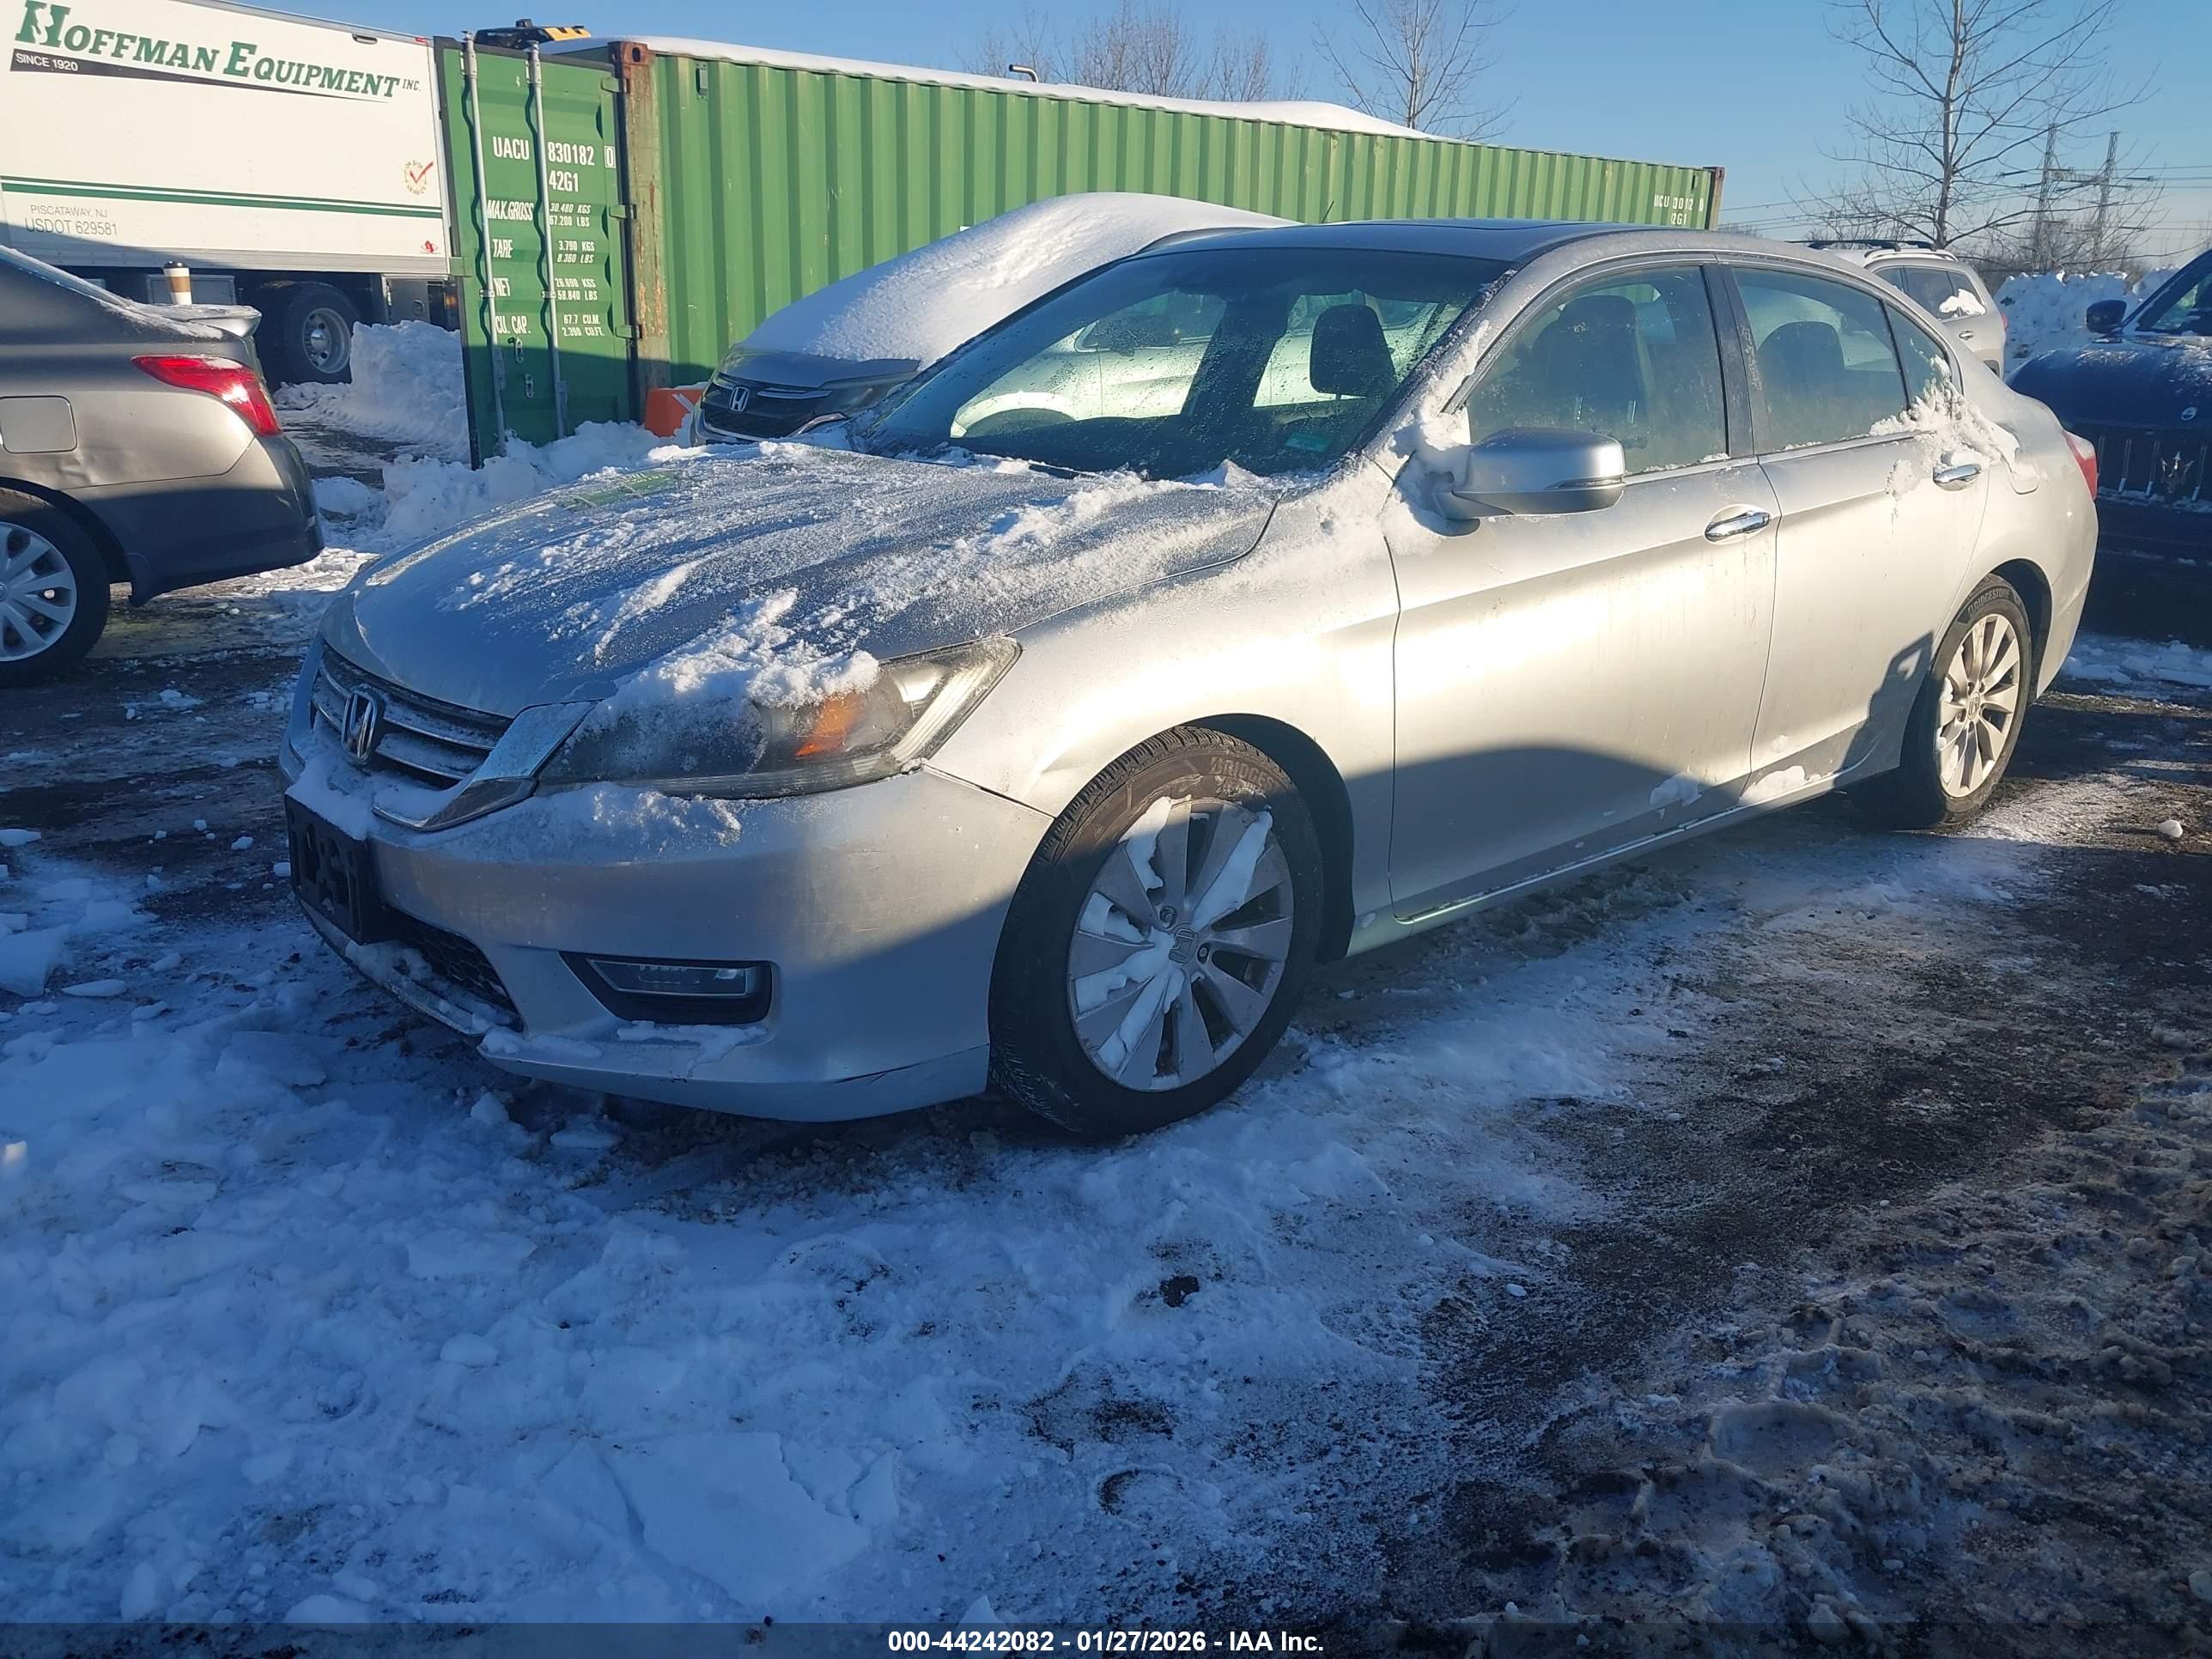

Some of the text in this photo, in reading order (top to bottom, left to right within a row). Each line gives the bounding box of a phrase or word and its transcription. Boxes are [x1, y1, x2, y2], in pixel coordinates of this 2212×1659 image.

[15, 0, 421, 98] HOFFMAN EQUIPMENT INC.
[15, 52, 78, 71] SINCE 1920
[492, 137, 615, 167] UACU 830182 0
[549, 170, 579, 193] 42G1
[96, 210, 108, 218] NJ
[576, 204, 592, 214] KGS
[25, 218, 118, 236] USDOT 629581
[576, 216, 590, 228] LBS
[492, 239, 513, 258] TARE
[558, 240, 595, 252] 3.790 KGS
[580, 254, 594, 264] LBS
[493, 277, 511, 297] NET
[581, 278, 596, 288] KGS
[557, 290, 598, 301] 58.840 LBS
[495, 315, 532, 334] CU. CAP.
[563, 314, 579, 325] 67.7
